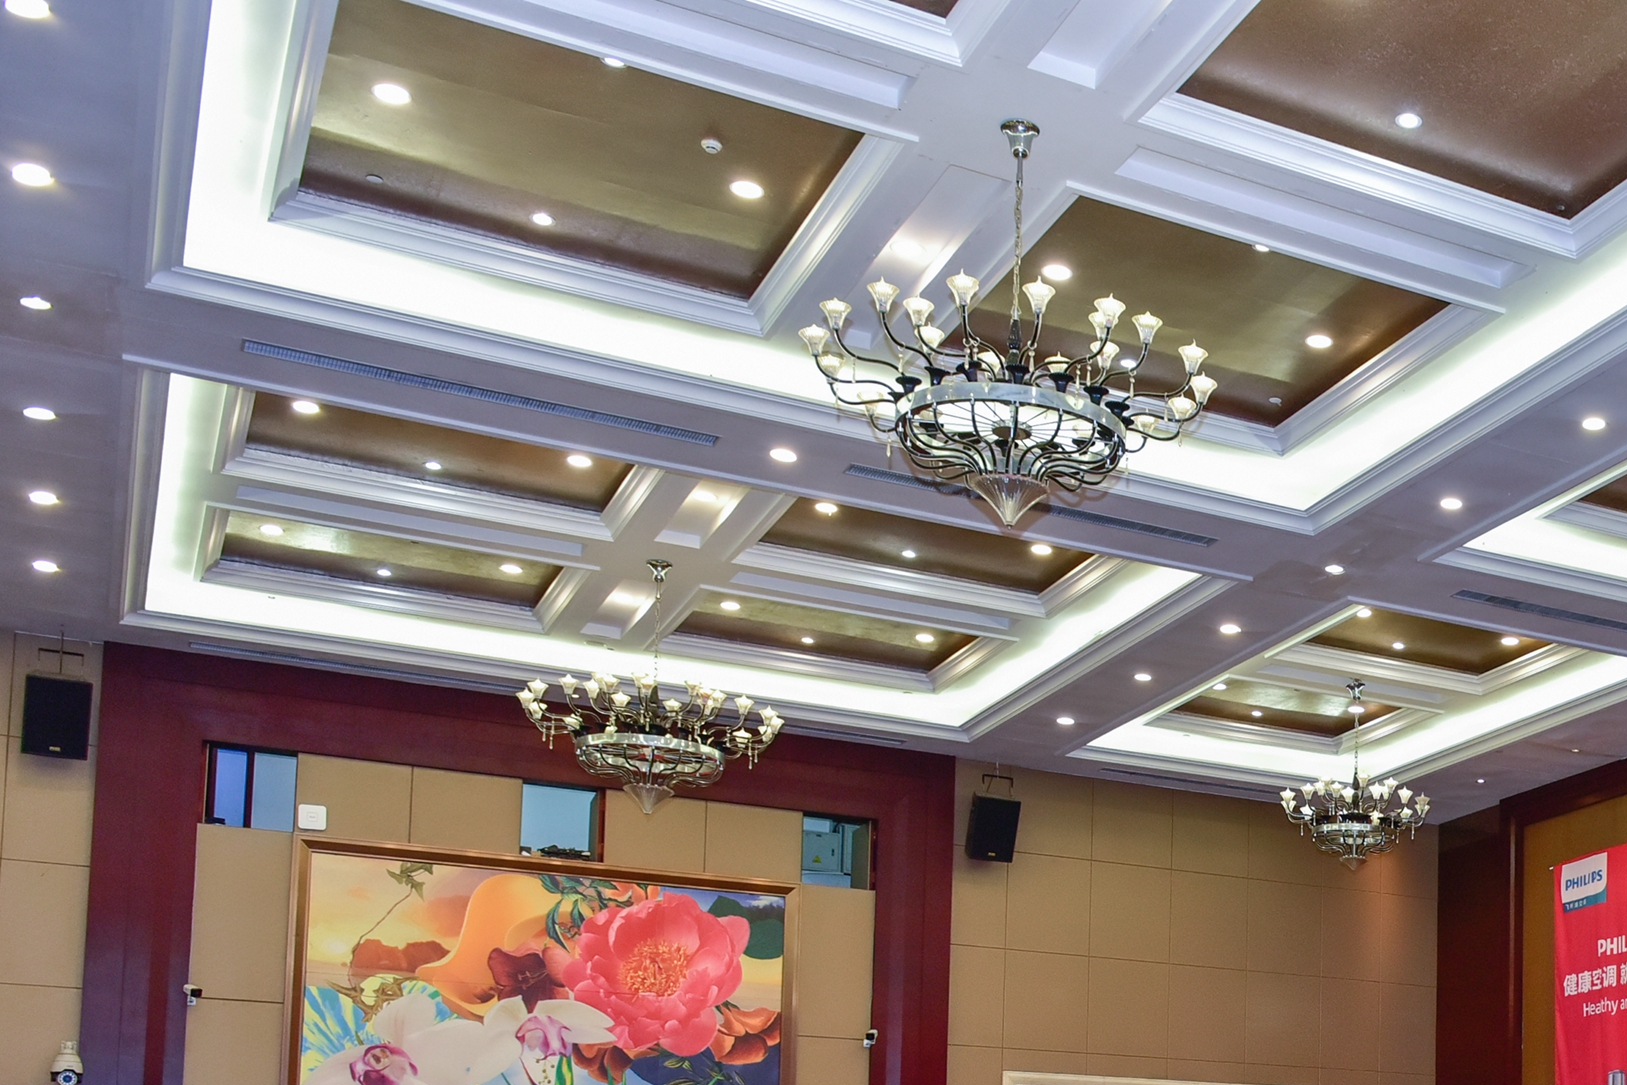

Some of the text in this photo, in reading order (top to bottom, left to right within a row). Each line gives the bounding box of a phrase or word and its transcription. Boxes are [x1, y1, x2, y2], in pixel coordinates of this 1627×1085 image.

[1565, 869, 1603, 891] PHILIPS
[1563, 965, 1617, 997] 健康空调
